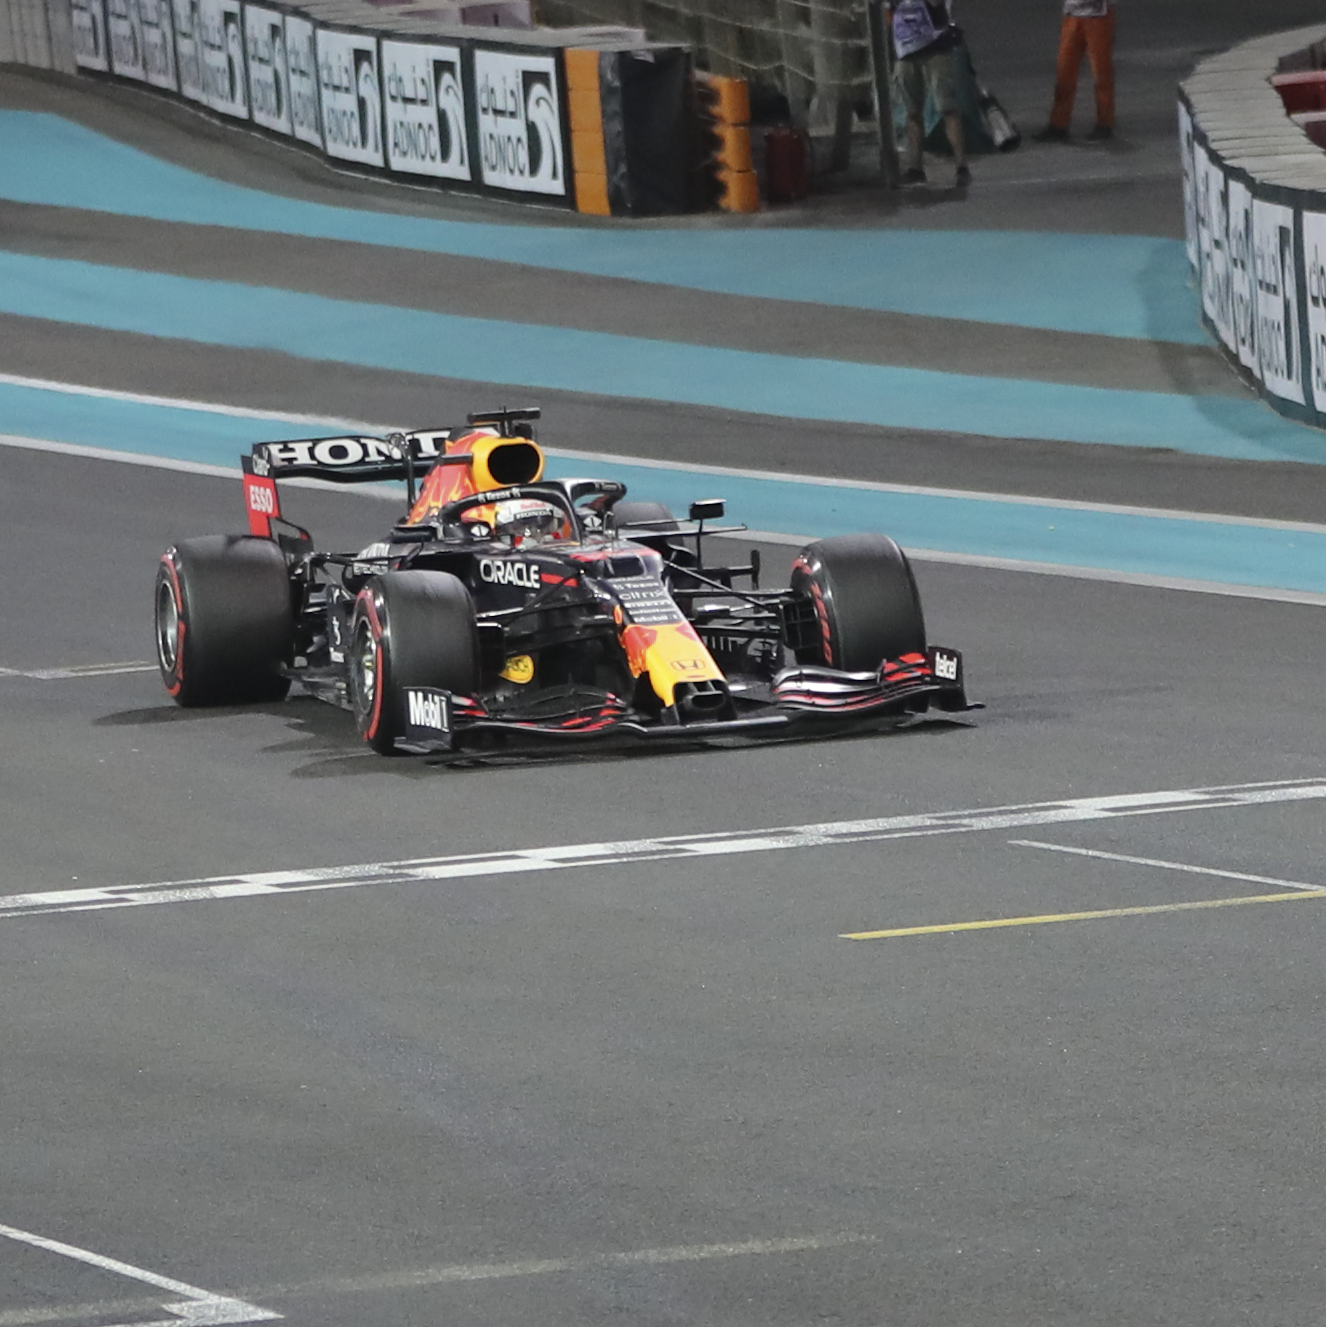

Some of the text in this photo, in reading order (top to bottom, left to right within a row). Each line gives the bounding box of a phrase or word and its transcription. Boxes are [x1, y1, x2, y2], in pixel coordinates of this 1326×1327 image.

[327, 105, 359, 149] ADNOC
[392, 120, 439, 162] ADNOC
[483, 131, 527, 176] ADNOC
[267, 431, 451, 467] HOND
[479, 559, 541, 589] ORACLE
[408, 691, 442, 729] Mobil
